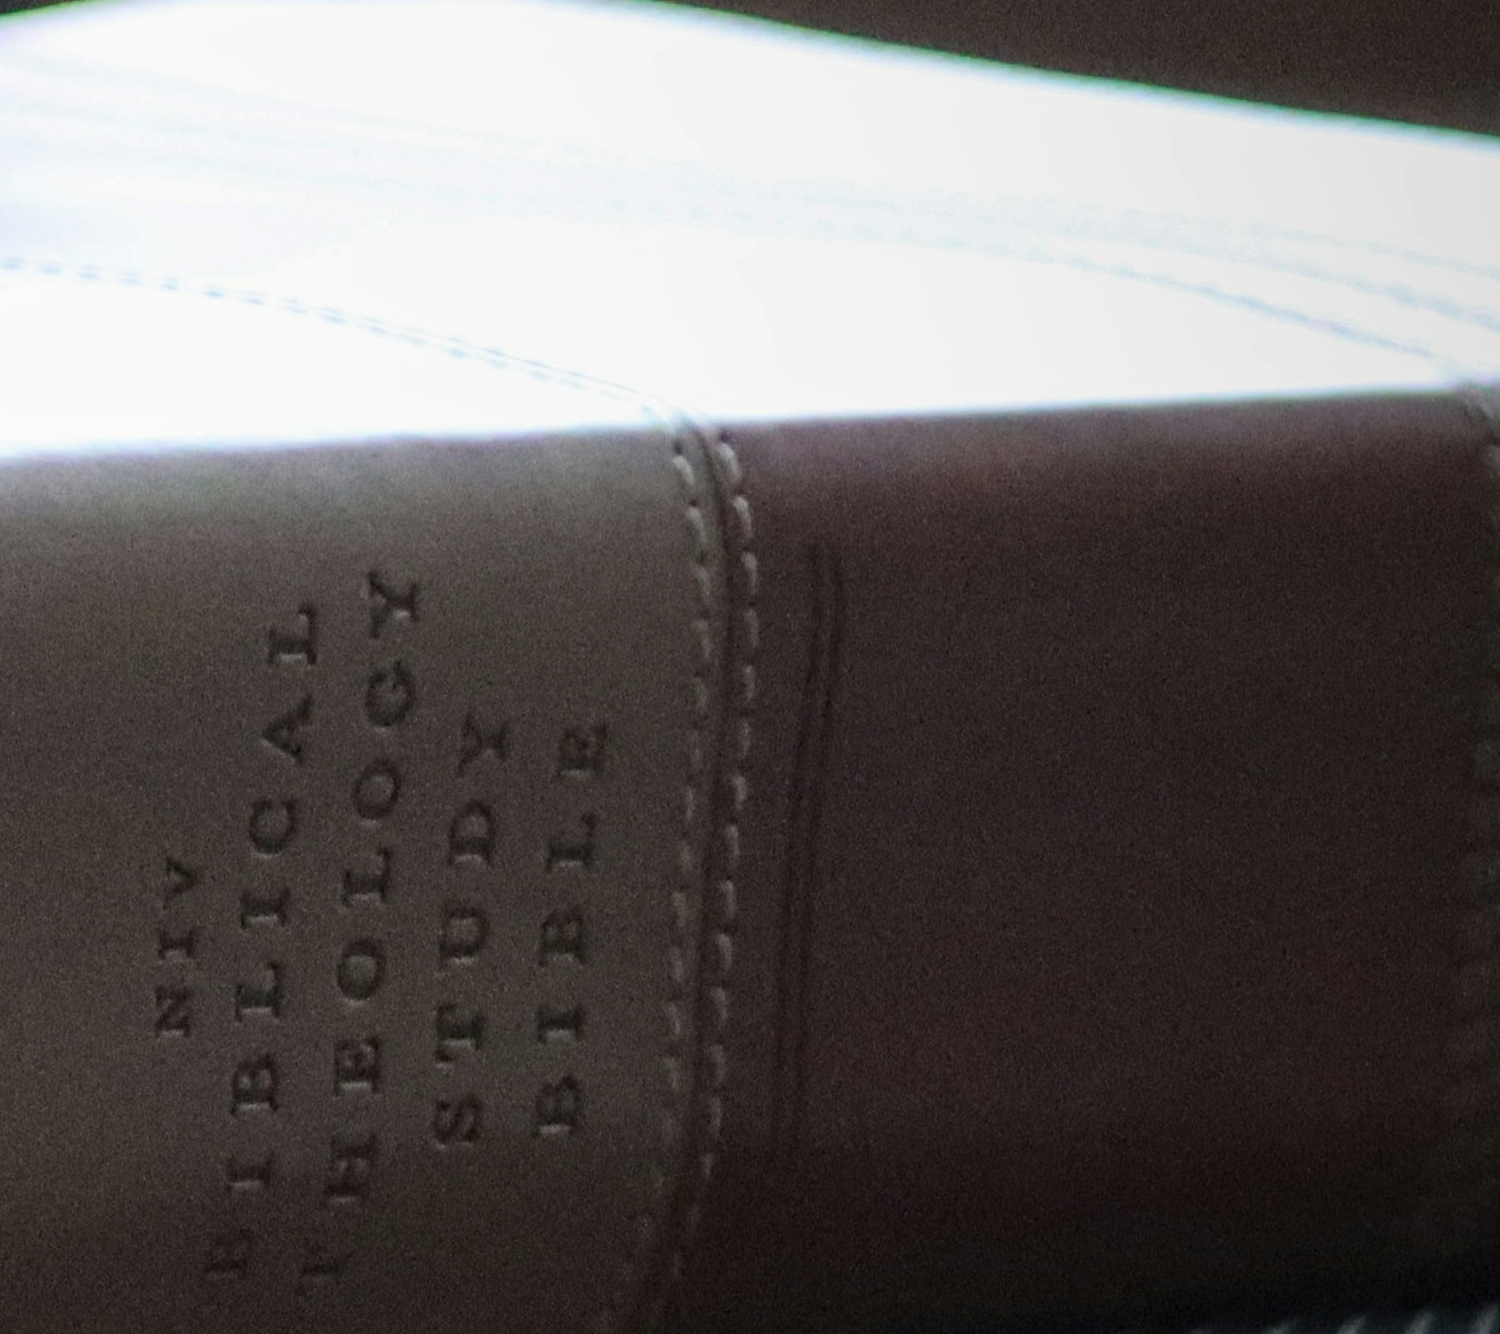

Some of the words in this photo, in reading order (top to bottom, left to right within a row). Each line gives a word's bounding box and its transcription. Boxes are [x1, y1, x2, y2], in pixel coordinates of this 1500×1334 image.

[155, 857, 199, 1037] NIV
[198, 602, 319, 1272] BIBLICAL
[302, 570, 420, 1288] THEOLOGY
[433, 711, 510, 1147] STUDY
[534, 722, 608, 1137] BIBLE
